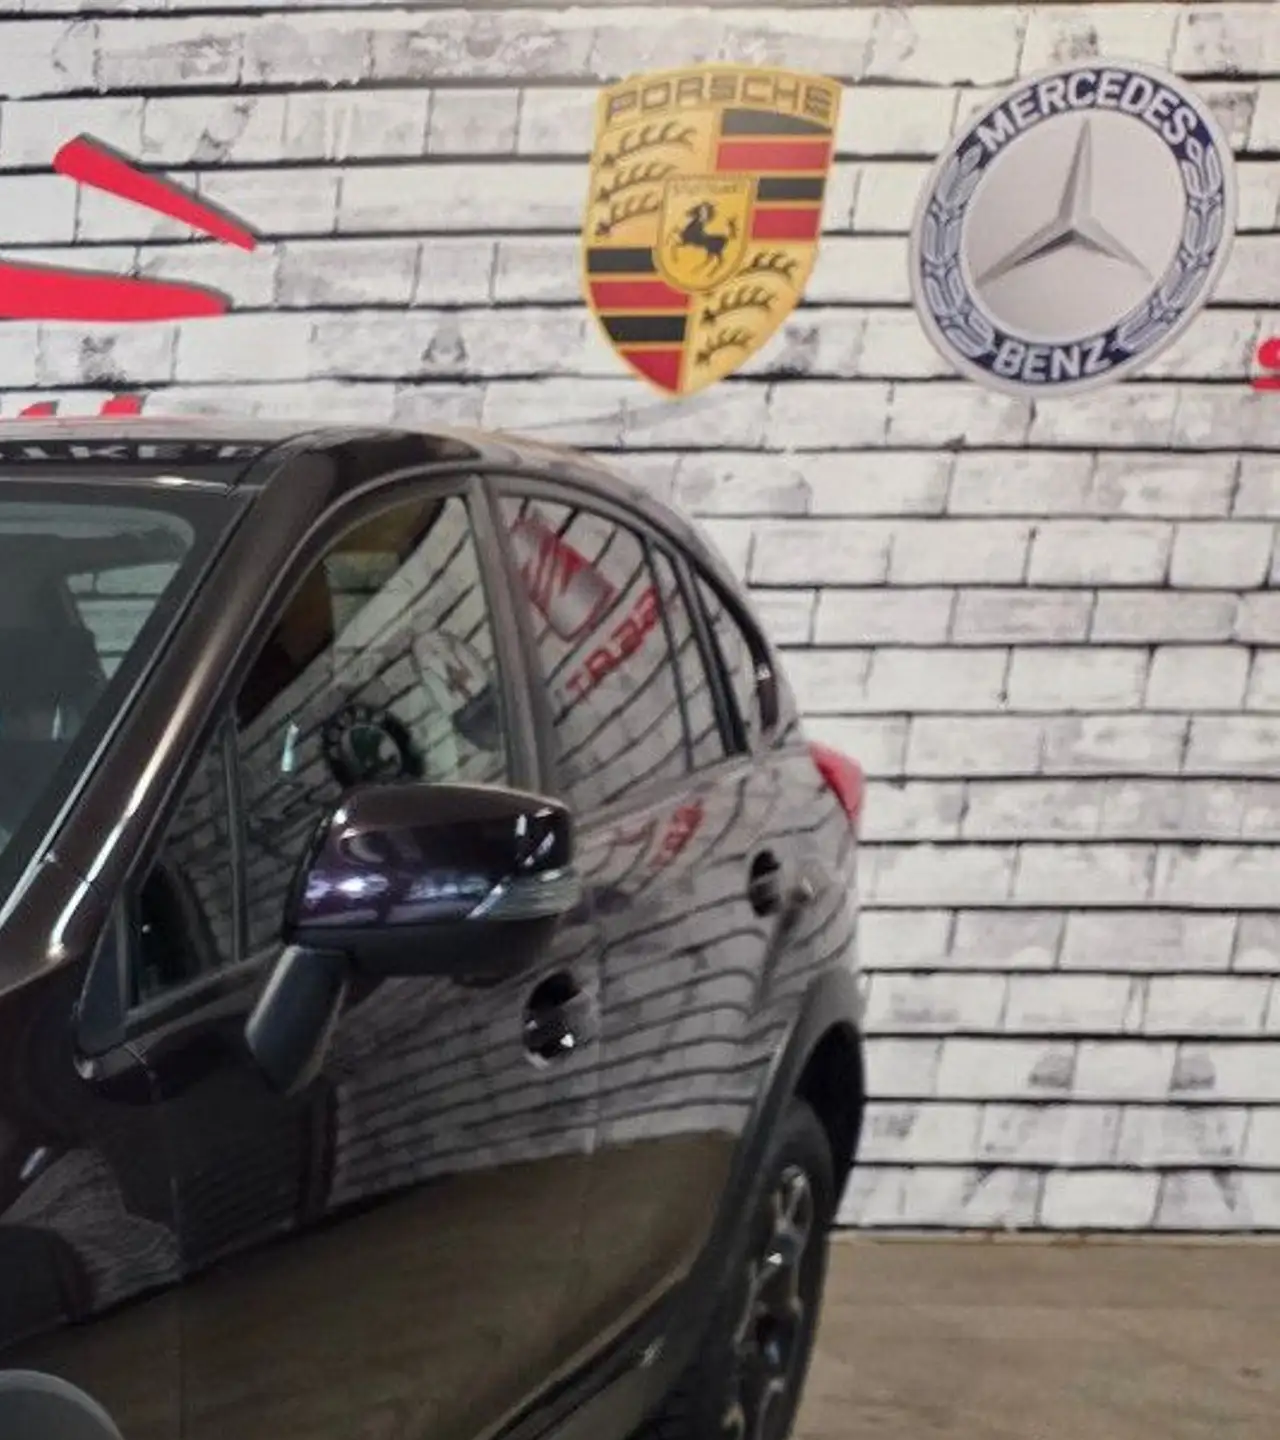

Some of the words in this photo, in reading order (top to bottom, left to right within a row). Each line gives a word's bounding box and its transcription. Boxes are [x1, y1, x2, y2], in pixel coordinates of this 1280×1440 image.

[605, 75, 833, 125] PORSCHE
[975, 69, 1198, 150] MERCEDES
[991, 336, 1113, 382] BENZ
